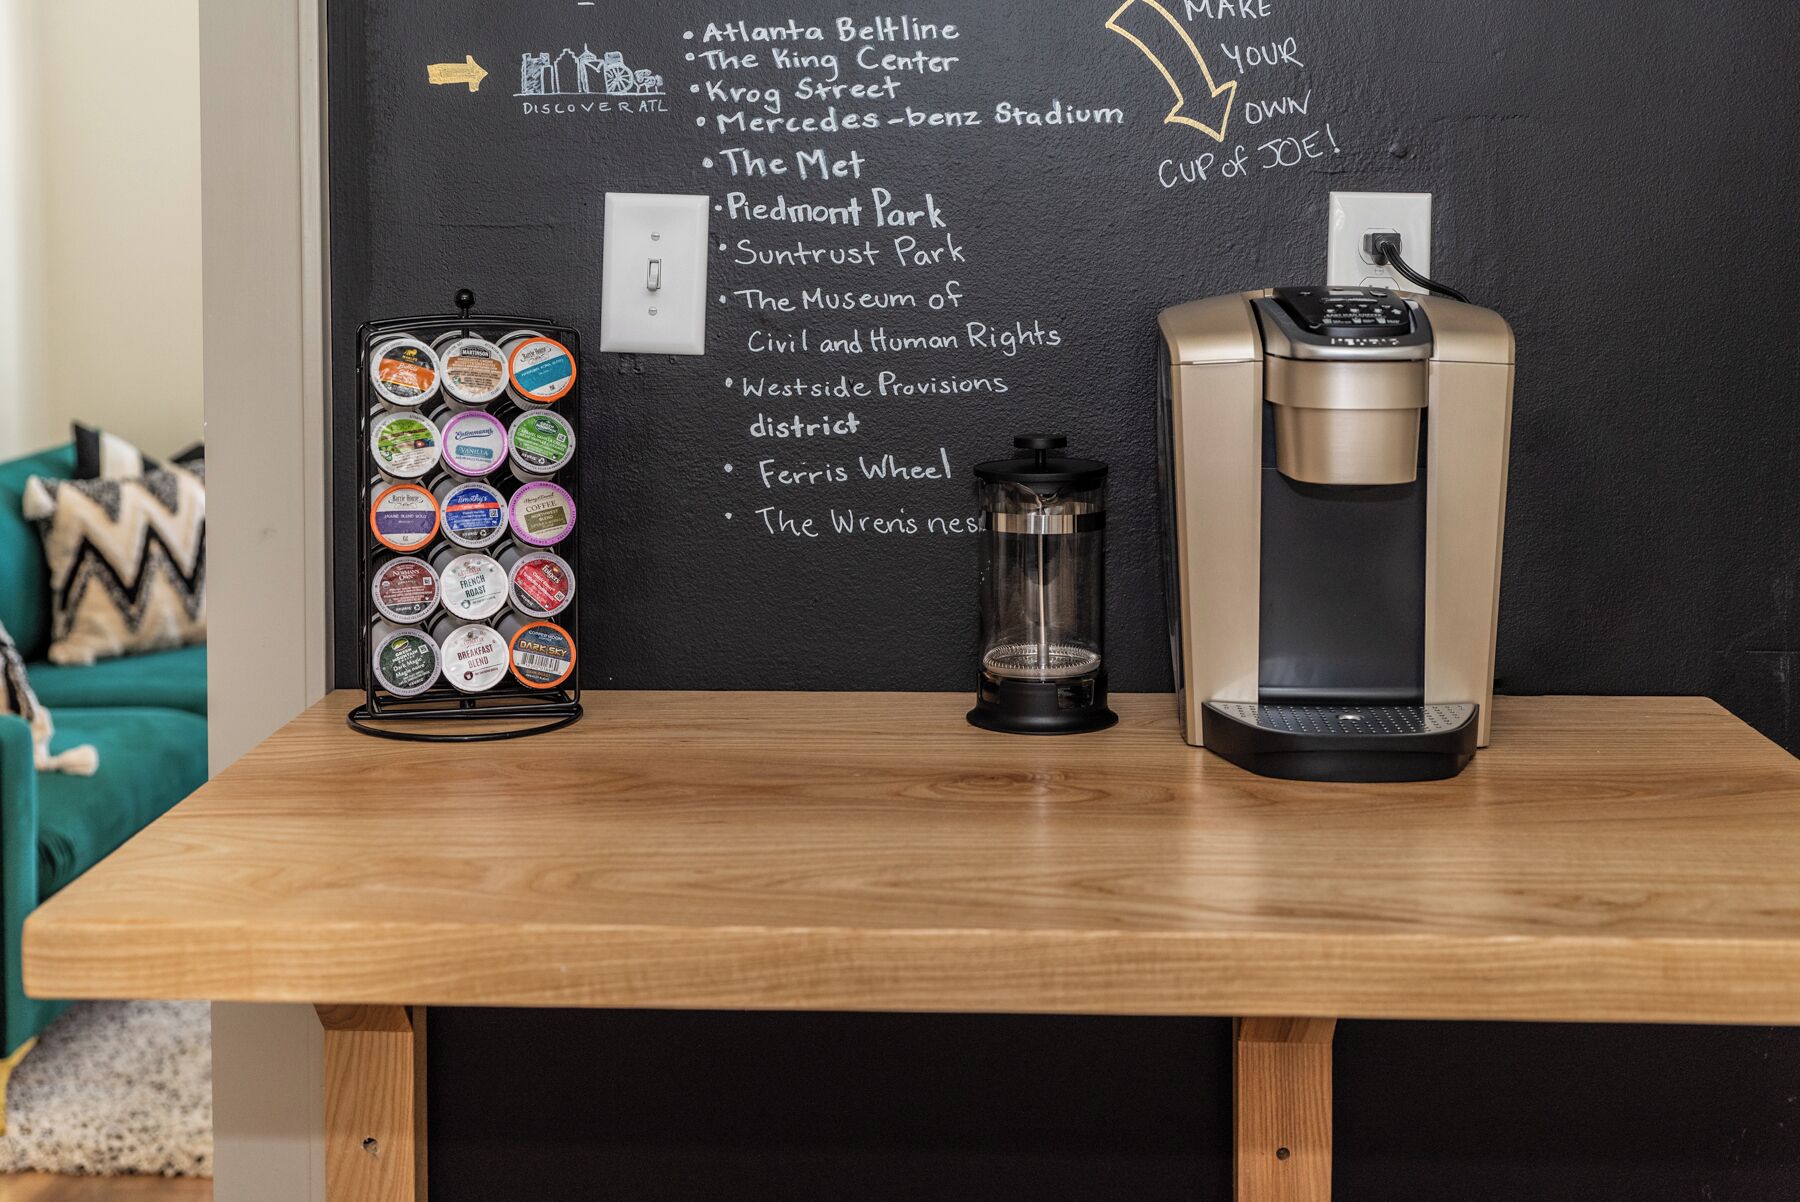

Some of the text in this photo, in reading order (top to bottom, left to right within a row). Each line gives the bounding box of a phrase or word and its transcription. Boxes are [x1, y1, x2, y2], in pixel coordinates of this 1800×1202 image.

[1183, 0, 1271, 22] MAKE
[702, 14, 961, 43] Atlanta Beltline
[697, 44, 960, 83] The King Center
[1220, 36, 1305, 75] YOUR
[522, 99, 669, 115] DISCOVER ATL
[705, 74, 902, 114] Krog Street
[1244, 88, 1312, 125] OWN
[994, 98, 1124, 127] Stadium
[718, 147, 866, 181] The Met
[1158, 119, 1341, 189] CUP of JOE!
[726, 187, 947, 229] Piedmont Park
[734, 232, 966, 267] Suntrust Park
[733, 280, 964, 312] The Museum of
[747, 319, 1062, 357] Civil and Human Rights
[742, 370, 1009, 398] Westside Provisions
[749, 411, 861, 438] district
[460, 447, 489, 456] VANILLA
[758, 447, 952, 489] Ferris Wheel
[525, 500, 557, 513] COFFEE
[754, 506, 819, 538] The
[830, 507, 918, 535] Wren's
[459, 574, 486, 589] FRENCH
[465, 585, 486, 598] ROAST
[457, 644, 494, 661] BREAKFAST
[467, 656, 489, 669] BLEND
[519, 640, 567, 657] DARK SKY
